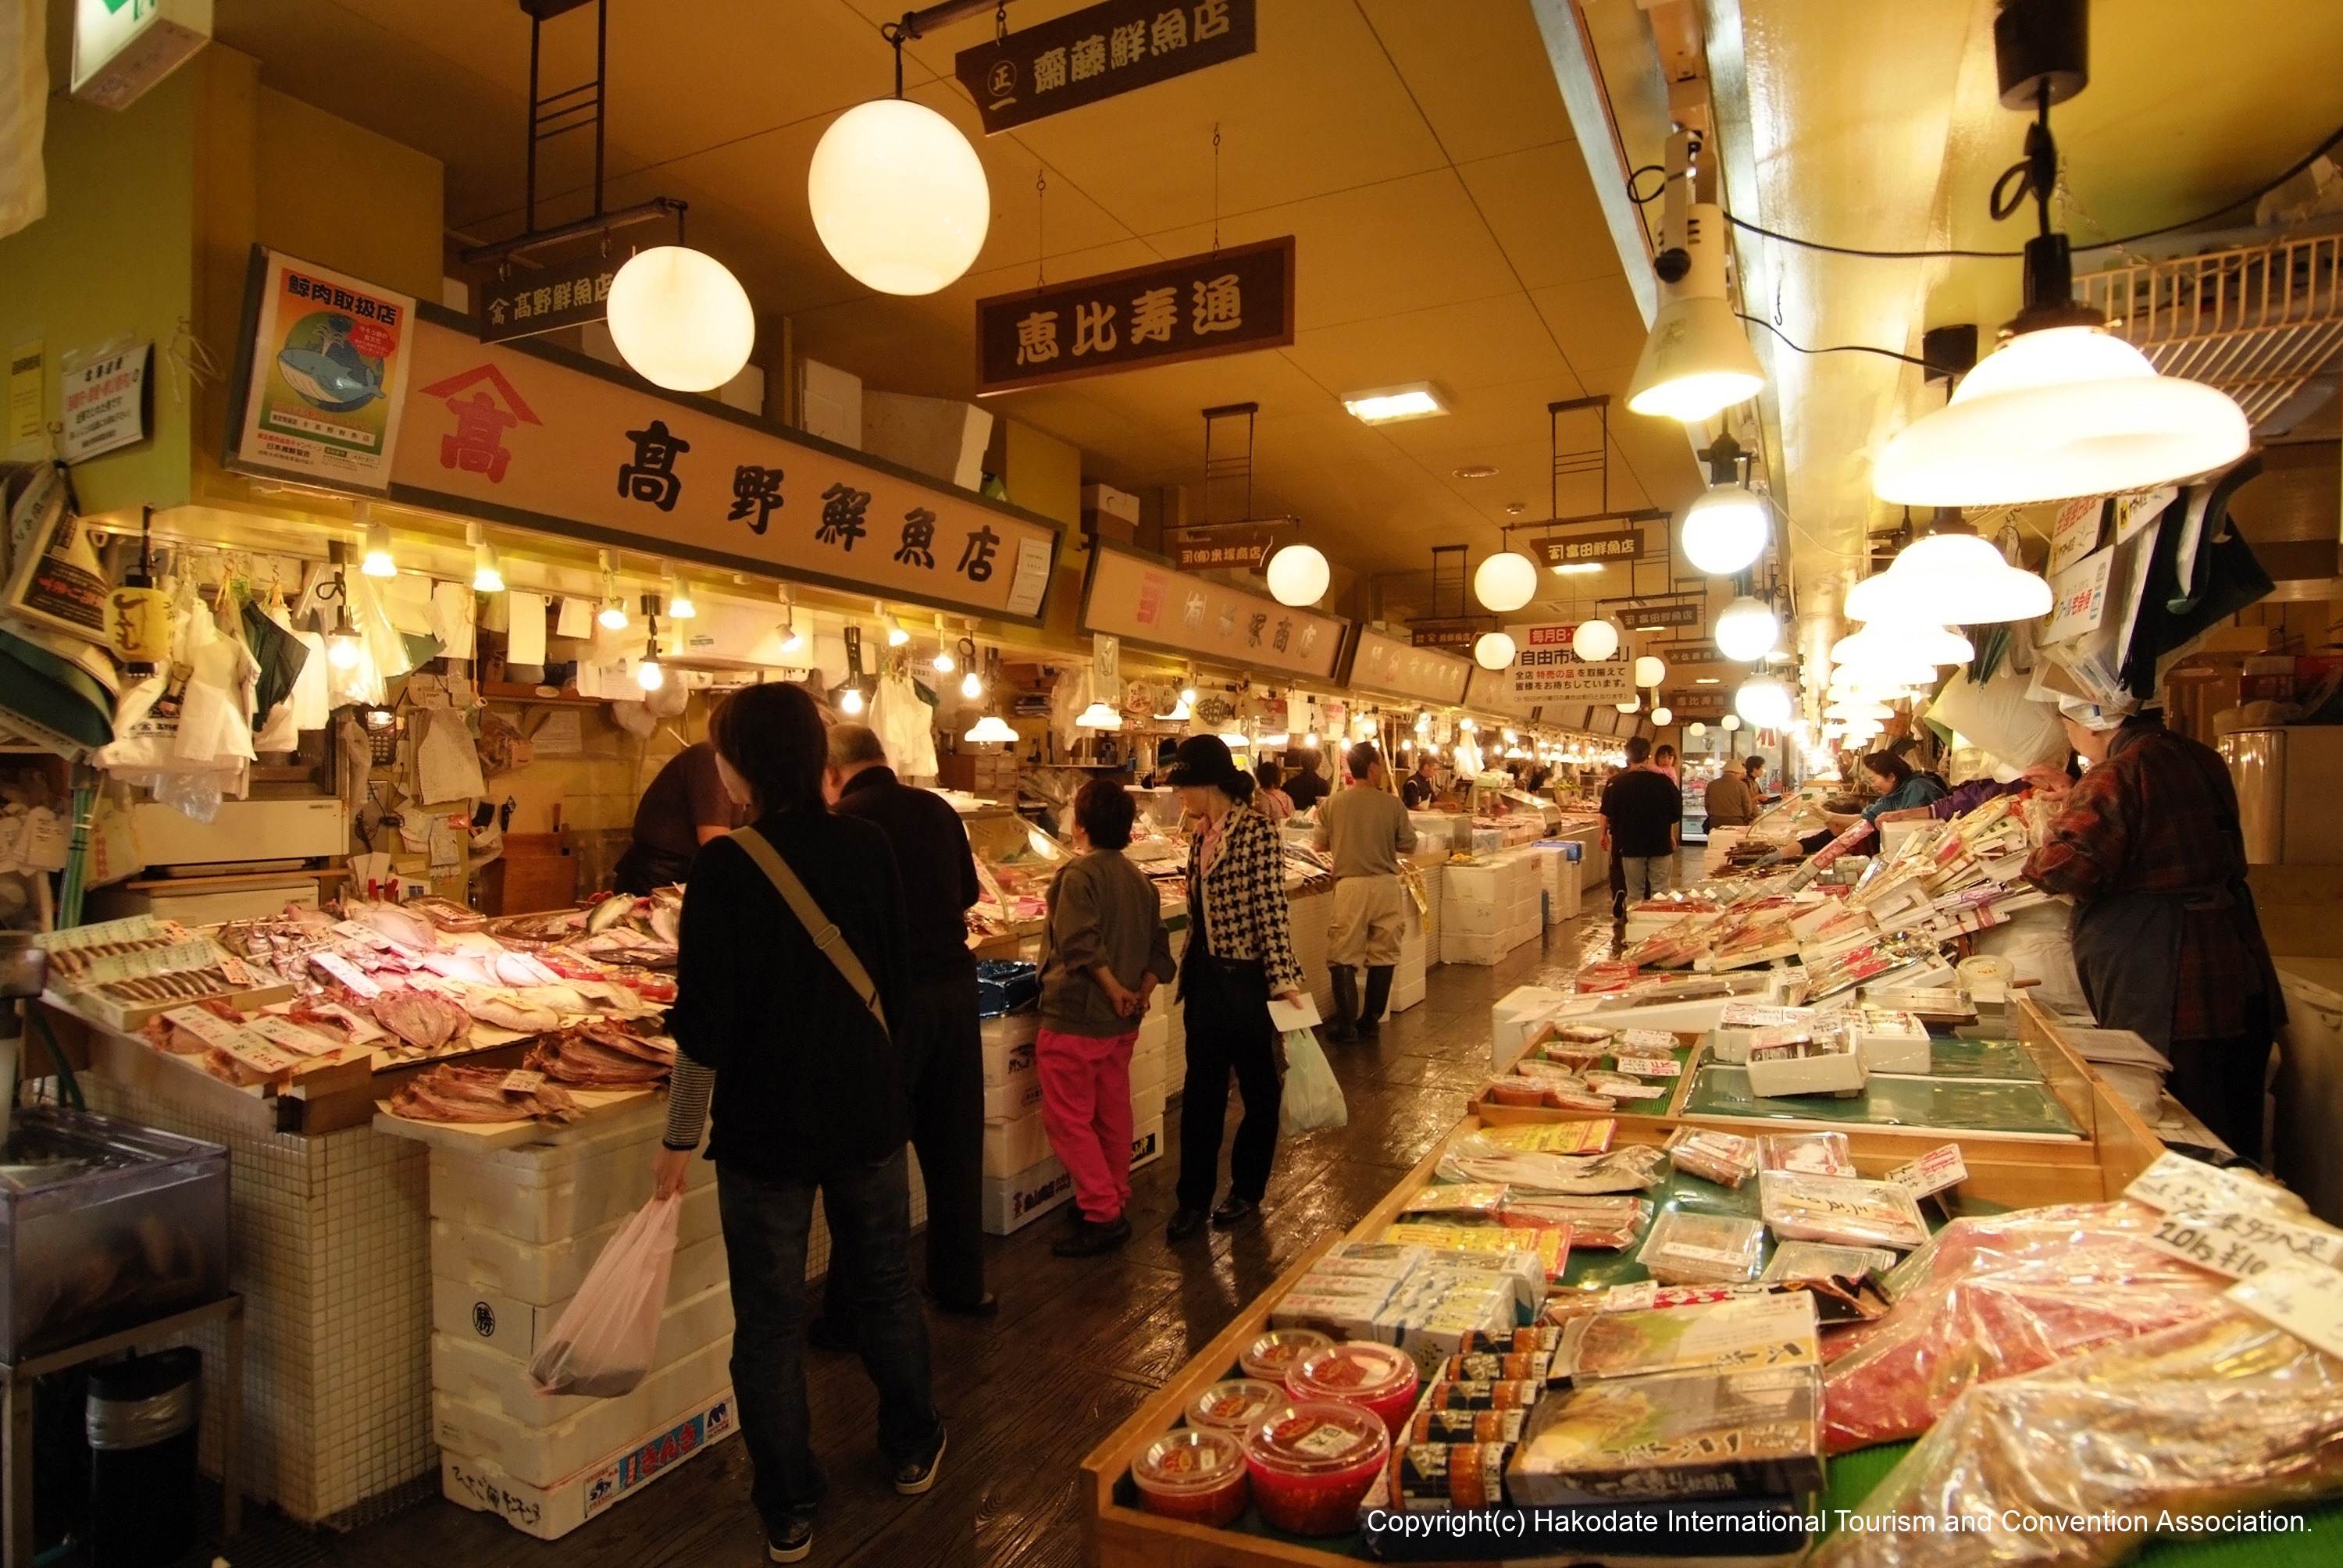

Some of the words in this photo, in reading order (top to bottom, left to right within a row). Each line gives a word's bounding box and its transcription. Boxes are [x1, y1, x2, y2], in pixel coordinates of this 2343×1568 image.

[287, 274, 397, 326] 鯨肉取扱店
[1017, 274, 1243, 365] 恵比寿通
[1532, 628, 1574, 643] 毎月8・
[1515, 670, 1534, 680] 全店
[1535, 669, 1574, 679] 特売の品
[1515, 679, 1627, 691] 皆様をお待ちしています。
